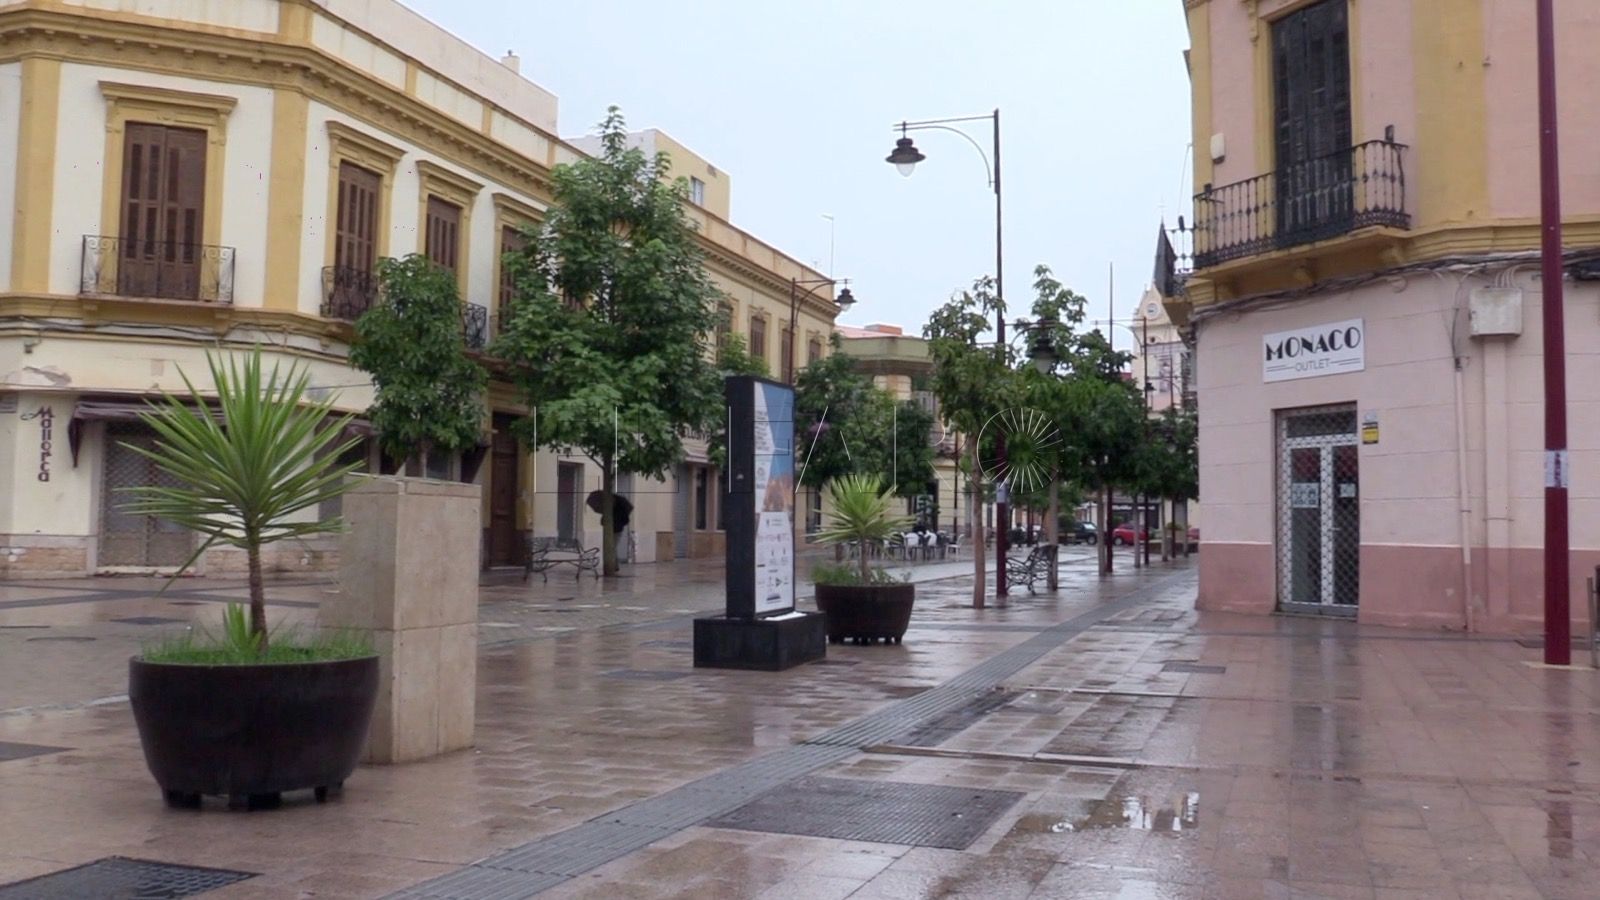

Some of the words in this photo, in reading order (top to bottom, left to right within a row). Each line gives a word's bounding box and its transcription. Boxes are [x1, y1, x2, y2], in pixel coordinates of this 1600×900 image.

[1265, 326, 1361, 361] MONACO
[1295, 358, 1330, 372] OUTLET
[20, 405, 55, 482] Mallorca
